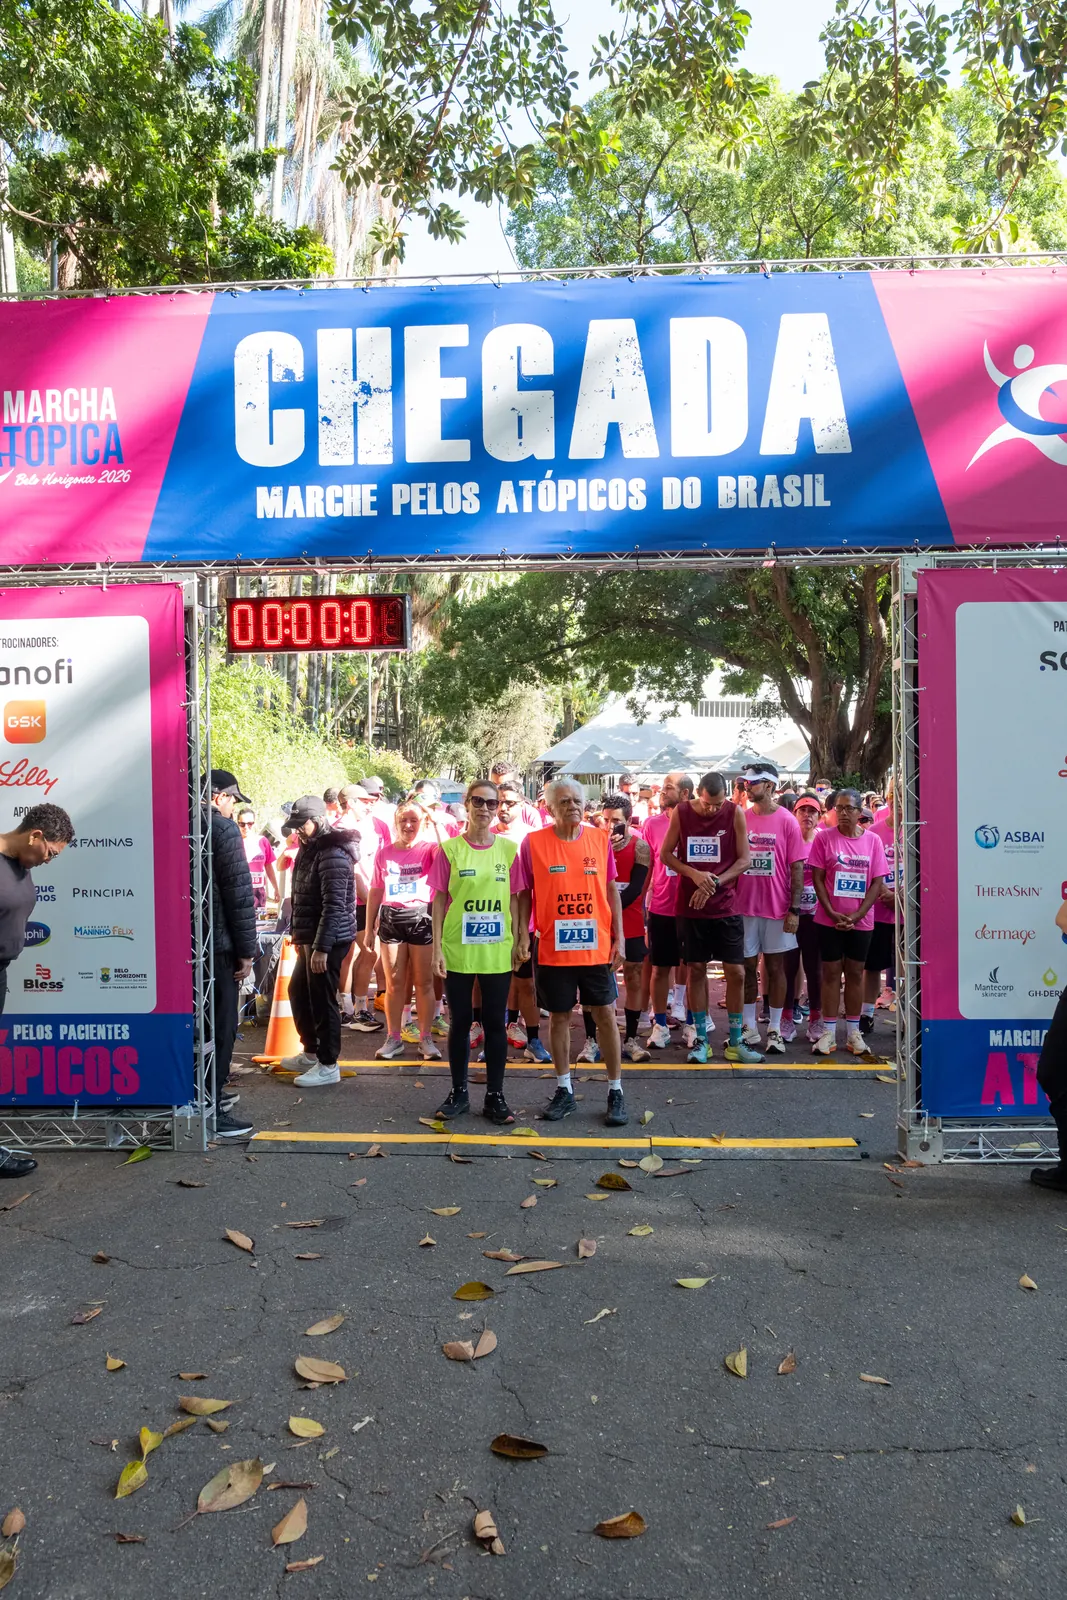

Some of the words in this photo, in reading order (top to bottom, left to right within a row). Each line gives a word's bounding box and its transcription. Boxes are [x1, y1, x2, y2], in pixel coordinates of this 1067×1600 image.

[234, 312, 853, 468] CHEGADA
[4, 387, 118, 424] MARCHA
[0, 416, 124, 468] TÓPICA
[14, 472, 40, 486] Belo
[42, 471, 97, 489] Horizonte
[98, 469, 132, 483] 2026
[256, 484, 378, 519] MARCHE
[392, 481, 481, 516] PELOS
[496, 470, 647, 514] ATÓPICOS
[662, 477, 702, 511] DO
[718, 474, 832, 509] BRASIL
[8, 715, 42, 728] GSK
[0, 758, 59, 796] Lilly
[80, 838, 134, 848] FAMINAS
[1004, 831, 1045, 843] ASBAI
[693, 844, 714, 854] 602
[840, 880, 861, 890] 571
[73, 887, 135, 898] PRINCIPIA
[557, 893, 592, 903] ATLETA
[463, 899, 502, 912] GUIA
[557, 903, 593, 915] CEGO
[74, 926, 112, 936] MANINHO
[471, 922, 496, 934] 720
[563, 929, 589, 940] 719
[974, 924, 1037, 946] dermage
[23, 979, 64, 989] Bless
[974, 983, 1015, 992] Mantecorp
[981, 990, 1007, 998] skincare
[13, 1024, 53, 1040] PELOS
[60, 1024, 130, 1040] PACIENTES
[981, 1052, 1051, 1105] AT
